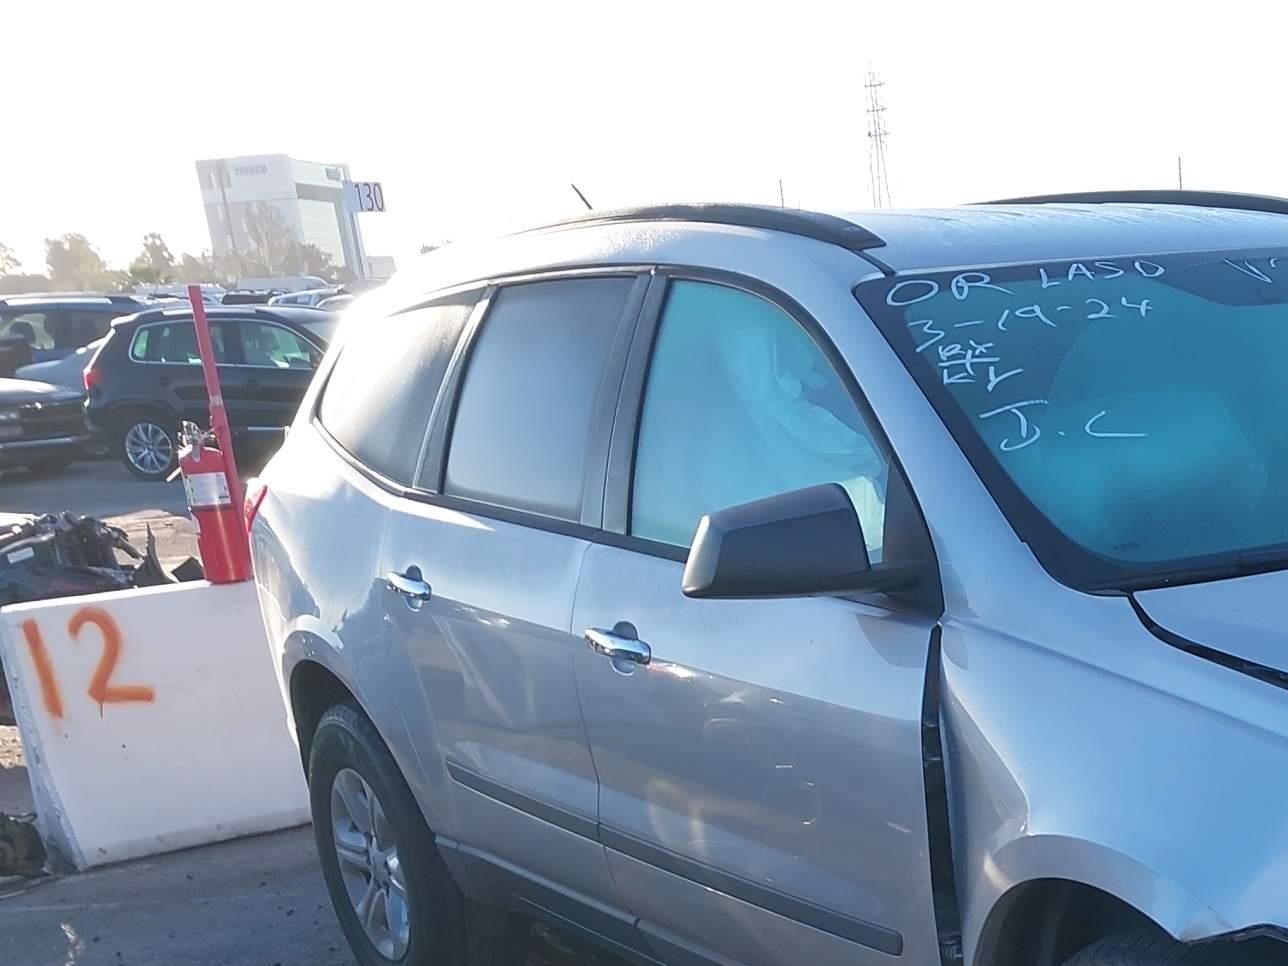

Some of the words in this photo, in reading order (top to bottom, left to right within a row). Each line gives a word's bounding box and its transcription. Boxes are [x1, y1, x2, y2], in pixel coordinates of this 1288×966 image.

[354, 182, 385, 212] 130
[886, 271, 1015, 306] OR
[21, 606, 156, 720] 12
